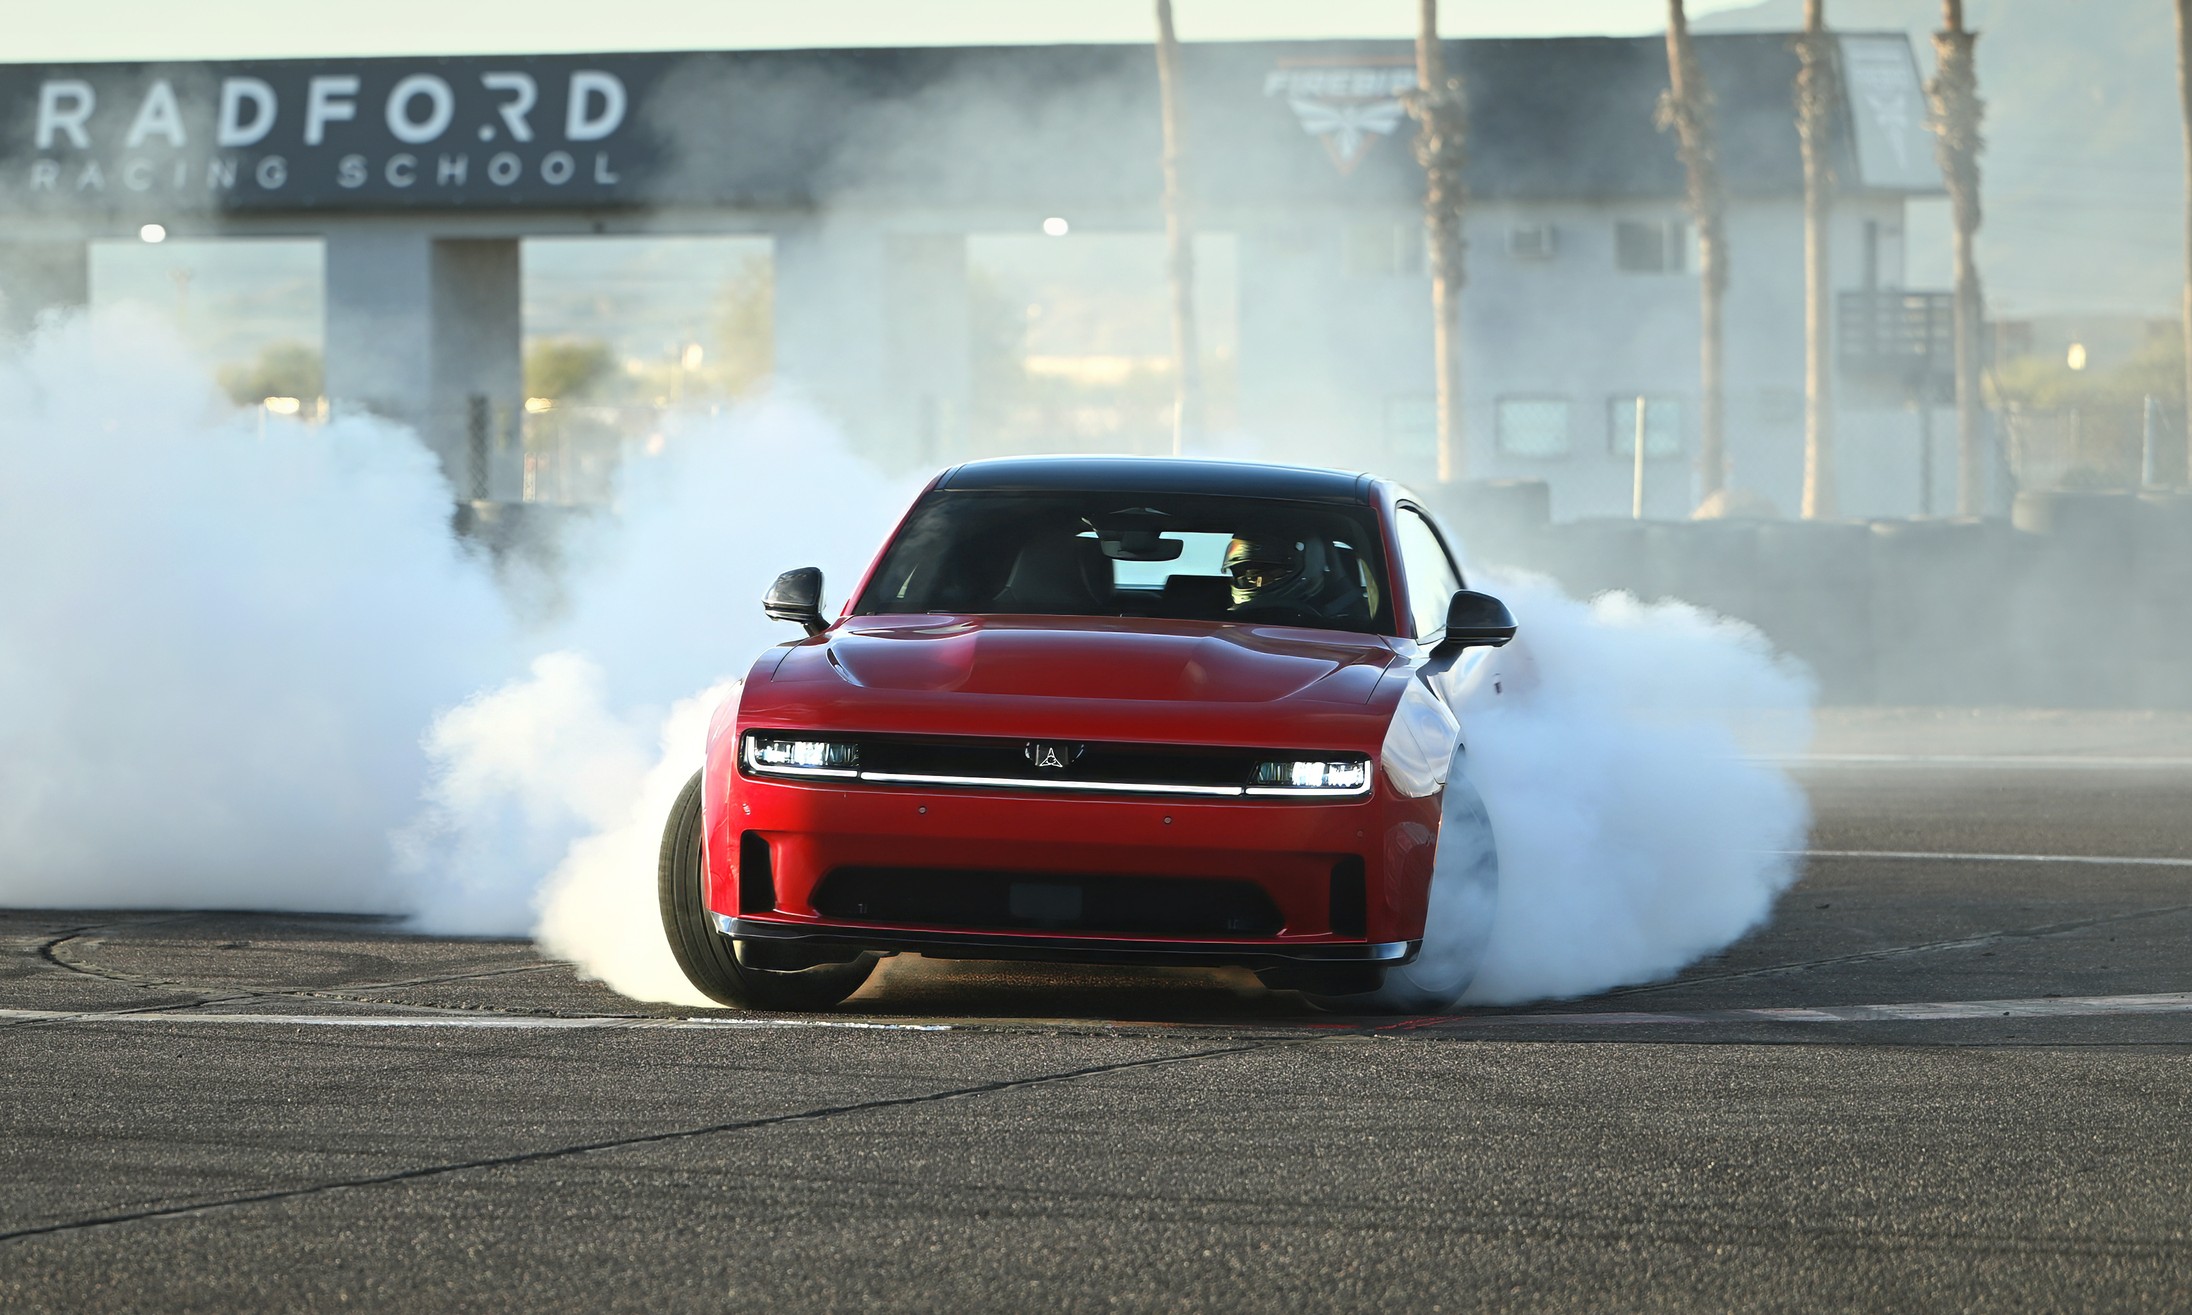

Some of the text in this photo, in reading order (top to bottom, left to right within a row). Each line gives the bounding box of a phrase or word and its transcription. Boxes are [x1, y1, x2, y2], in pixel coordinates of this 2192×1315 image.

[35, 70, 627, 149] RADFORD
[29, 151, 621, 192] RACING SCHOOL
